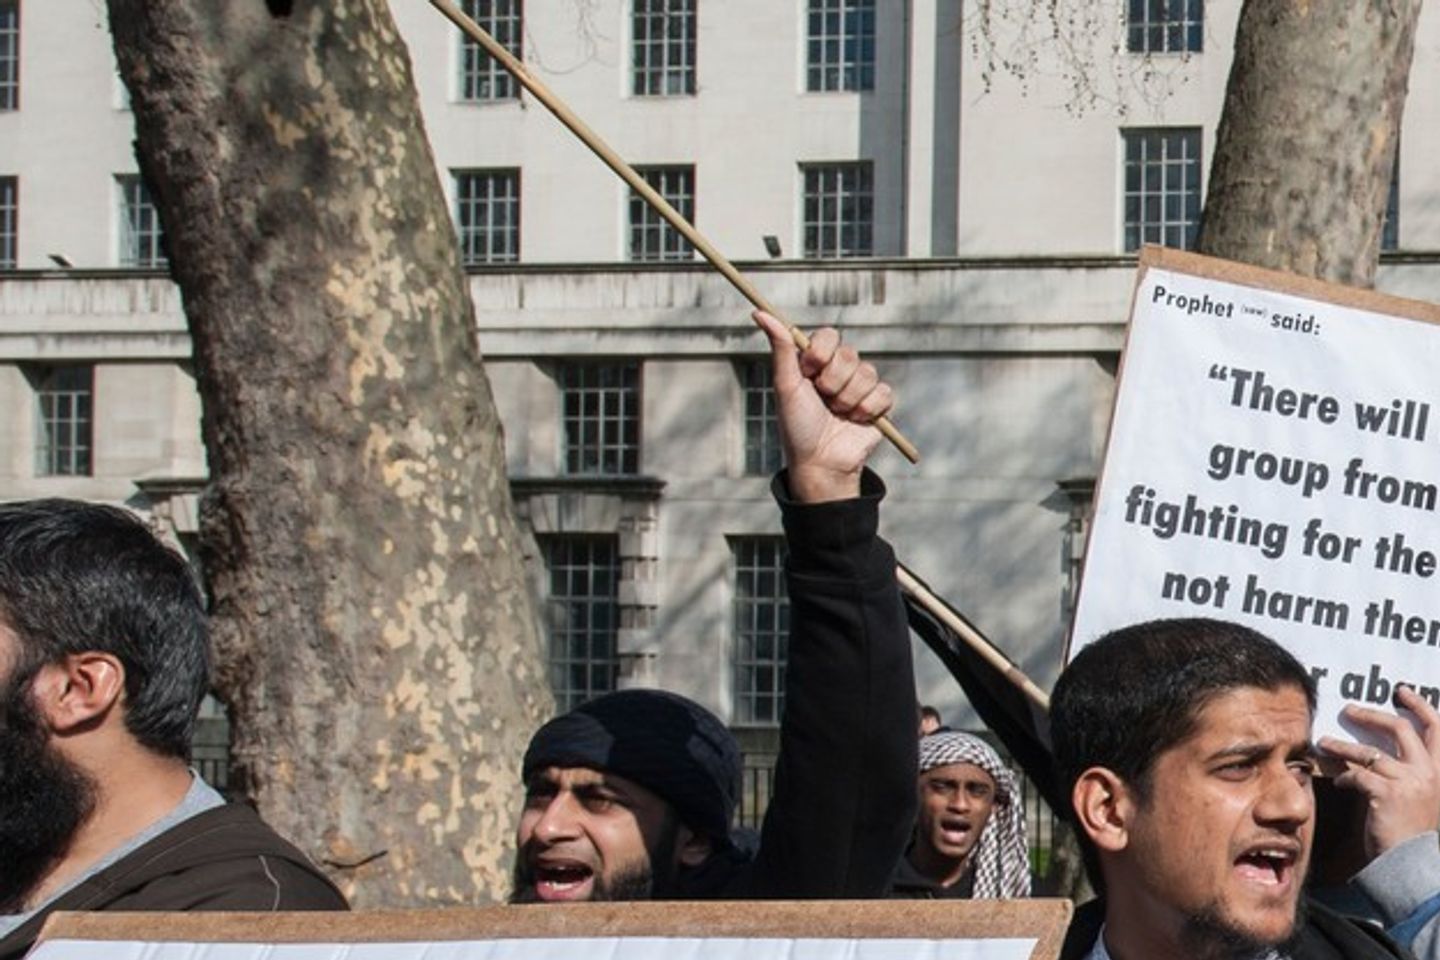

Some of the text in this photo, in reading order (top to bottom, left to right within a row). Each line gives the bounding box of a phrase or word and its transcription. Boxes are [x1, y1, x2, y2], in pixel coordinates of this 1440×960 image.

[1152, 285, 1234, 317] Prophet
[1270, 313, 1321, 335] said:
[1208, 364, 1340, 424] “There
[1356, 400, 1430, 442] will
[1207, 444, 1329, 498] group
[1344, 458, 1438, 512] from
[1125, 484, 1289, 560] fighting
[1302, 518, 1362, 564] for
[1375, 533, 1437, 578] the
[1161, 572, 1230, 609] not
[1242, 574, 1349, 631] harm
